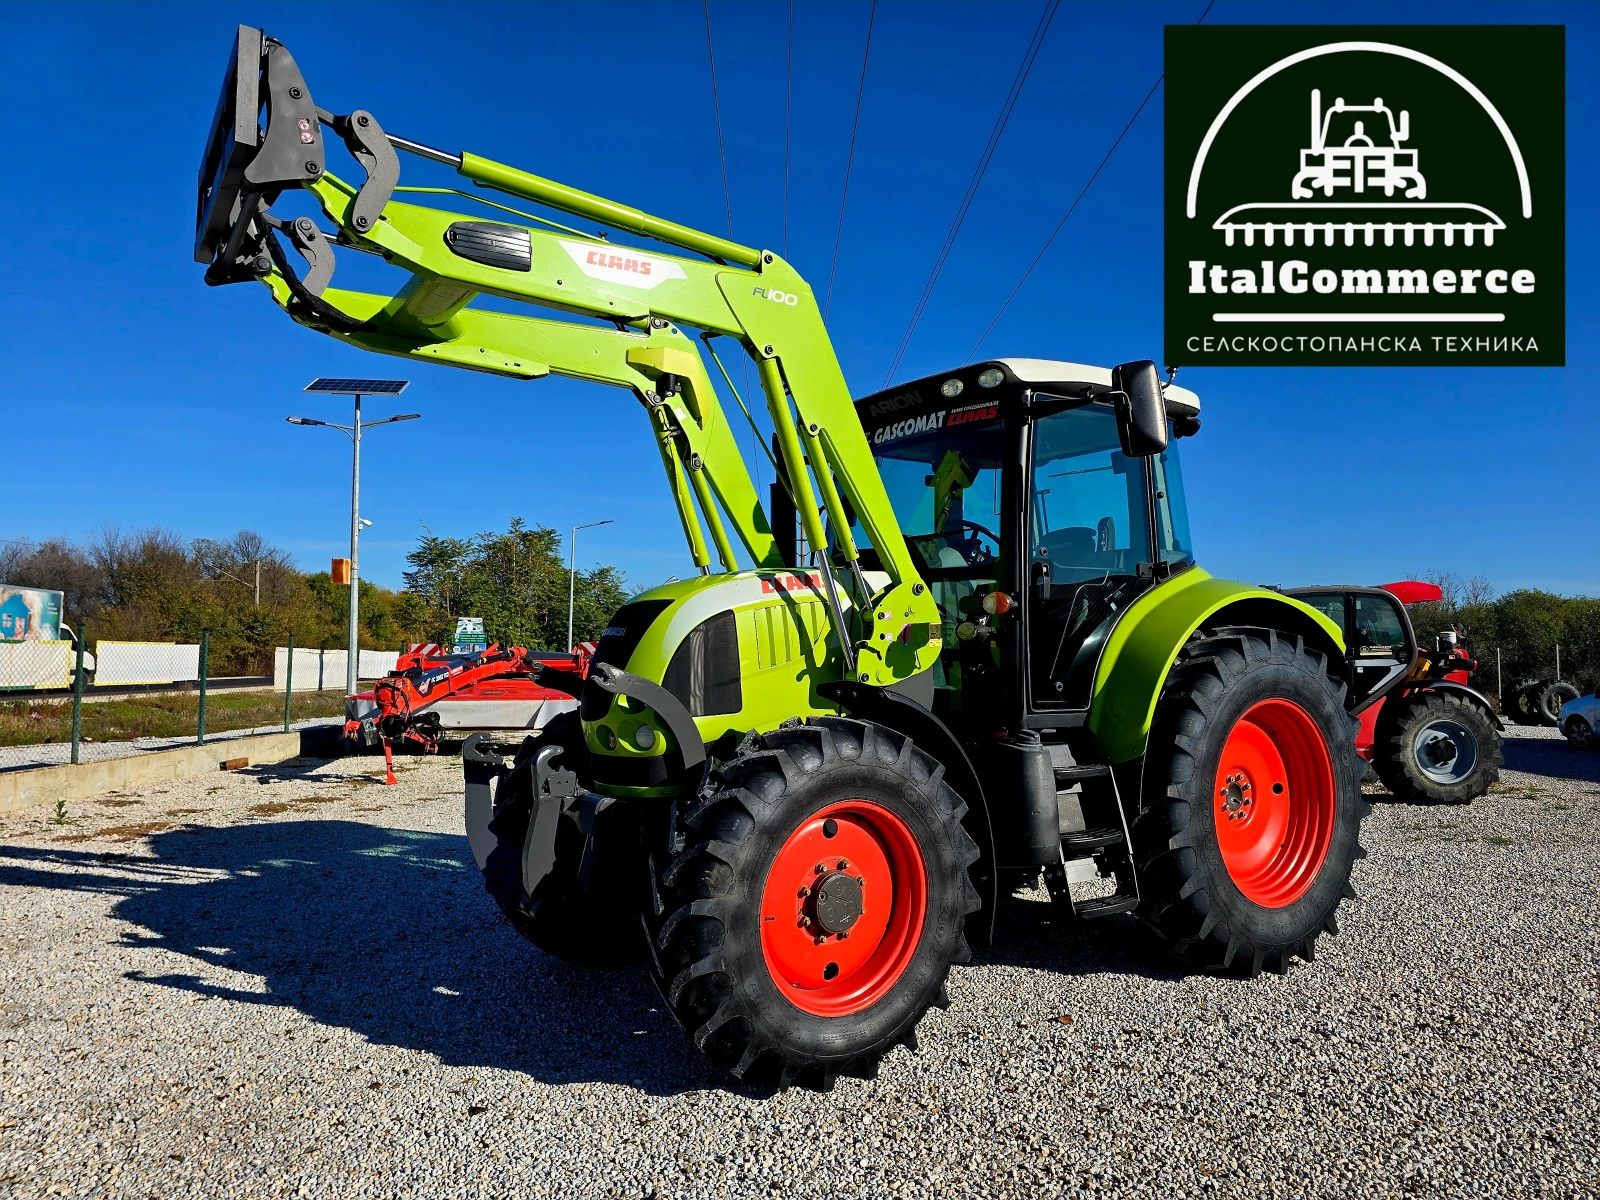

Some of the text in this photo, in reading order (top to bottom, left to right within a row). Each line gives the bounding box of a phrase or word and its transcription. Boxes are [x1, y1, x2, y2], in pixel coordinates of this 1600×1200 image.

[586, 250, 652, 276] CLAAS
[752, 286, 798, 306] FL100
[869, 390, 924, 417] ARION
[874, 410, 946, 444] GASCOMAT
[947, 406, 999, 426] CLAAS
[761, 573, 826, 594] CLAA
